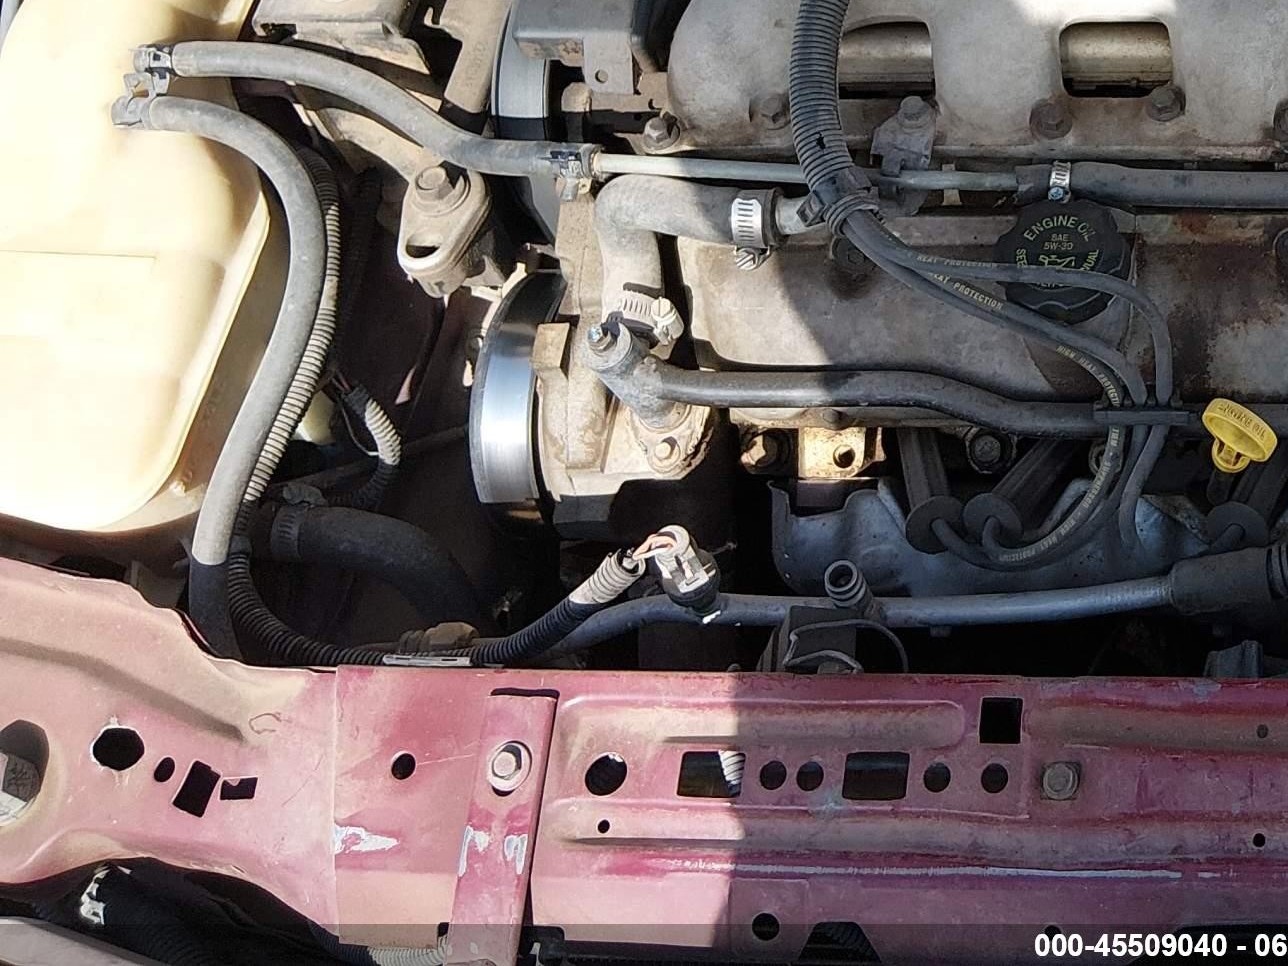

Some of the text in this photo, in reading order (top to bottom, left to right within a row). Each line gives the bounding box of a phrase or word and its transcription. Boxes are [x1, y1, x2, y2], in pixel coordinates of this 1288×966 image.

[1024, 215, 1096, 242] ENGINE OIL
[1016, 248, 1028, 268] SEE
[1043, 241, 1074, 251] 5W-30
[953, 282, 1004, 310] PROTECTION
[1099, 373, 1121, 407] PROTECTI
[1218, 403, 1252, 427] ENGINE
